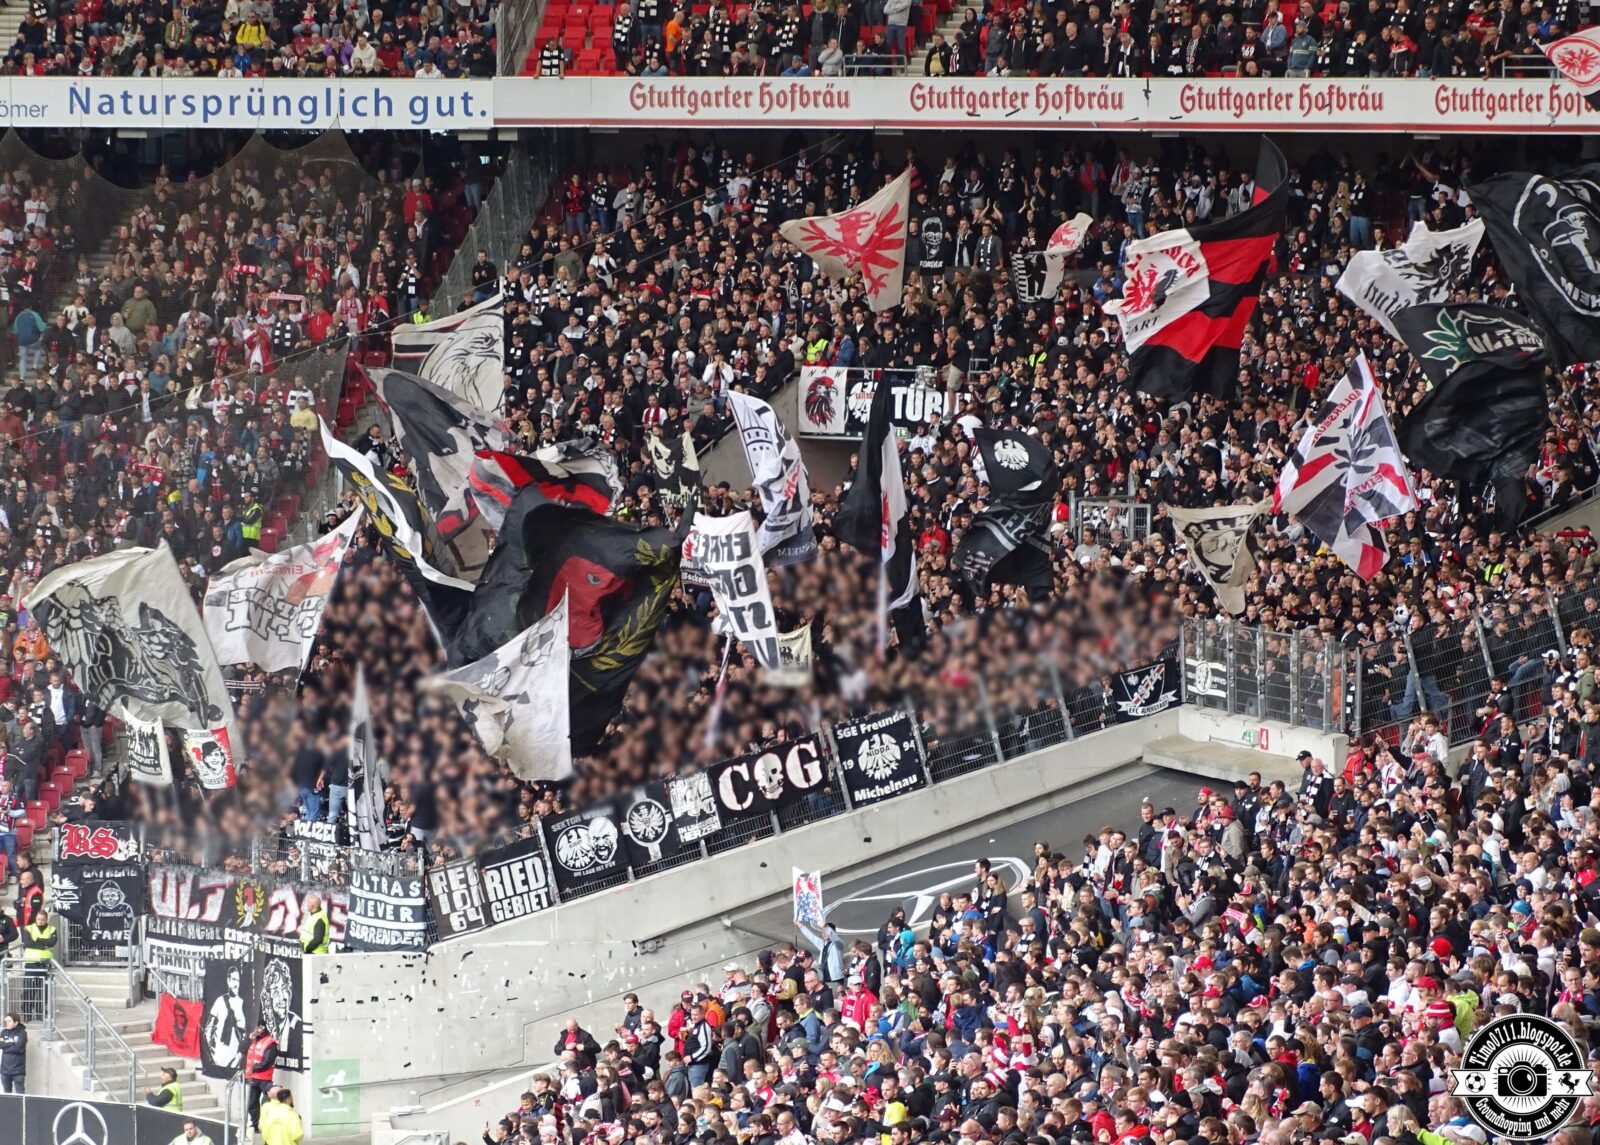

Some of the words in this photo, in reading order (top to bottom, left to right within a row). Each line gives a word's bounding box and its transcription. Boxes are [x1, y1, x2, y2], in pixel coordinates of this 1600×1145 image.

[68, 86, 394, 125] Natursprünglich
[408, 88, 488, 126] gut.
[629, 82, 752, 116] Stuttgarter
[759, 82, 850, 115] Hofbräu
[910, 82, 1028, 117] Stuttgarter
[1035, 82, 1124, 116] Hofbräu
[1179, 83, 1293, 118] Stuttgarter
[1299, 84, 1383, 116] Hofbräu
[1435, 84, 1544, 121] Stuttgarter
[837, 726, 859, 740] SGE
[860, 711, 906, 734] Freunde
[866, 745, 891, 758] NIDDA
[903, 740, 916, 752] 94
[842, 759, 854, 771] 19
[854, 774, 918, 802] Michelnau
[352, 871, 421, 897] ULTRAS
[483, 856, 546, 903] RIED
[355, 896, 414, 922] NEVER
[449, 906, 485, 932] 64
[490, 887, 549, 924] GEBIET
[349, 920, 426, 947] SURRENDER
